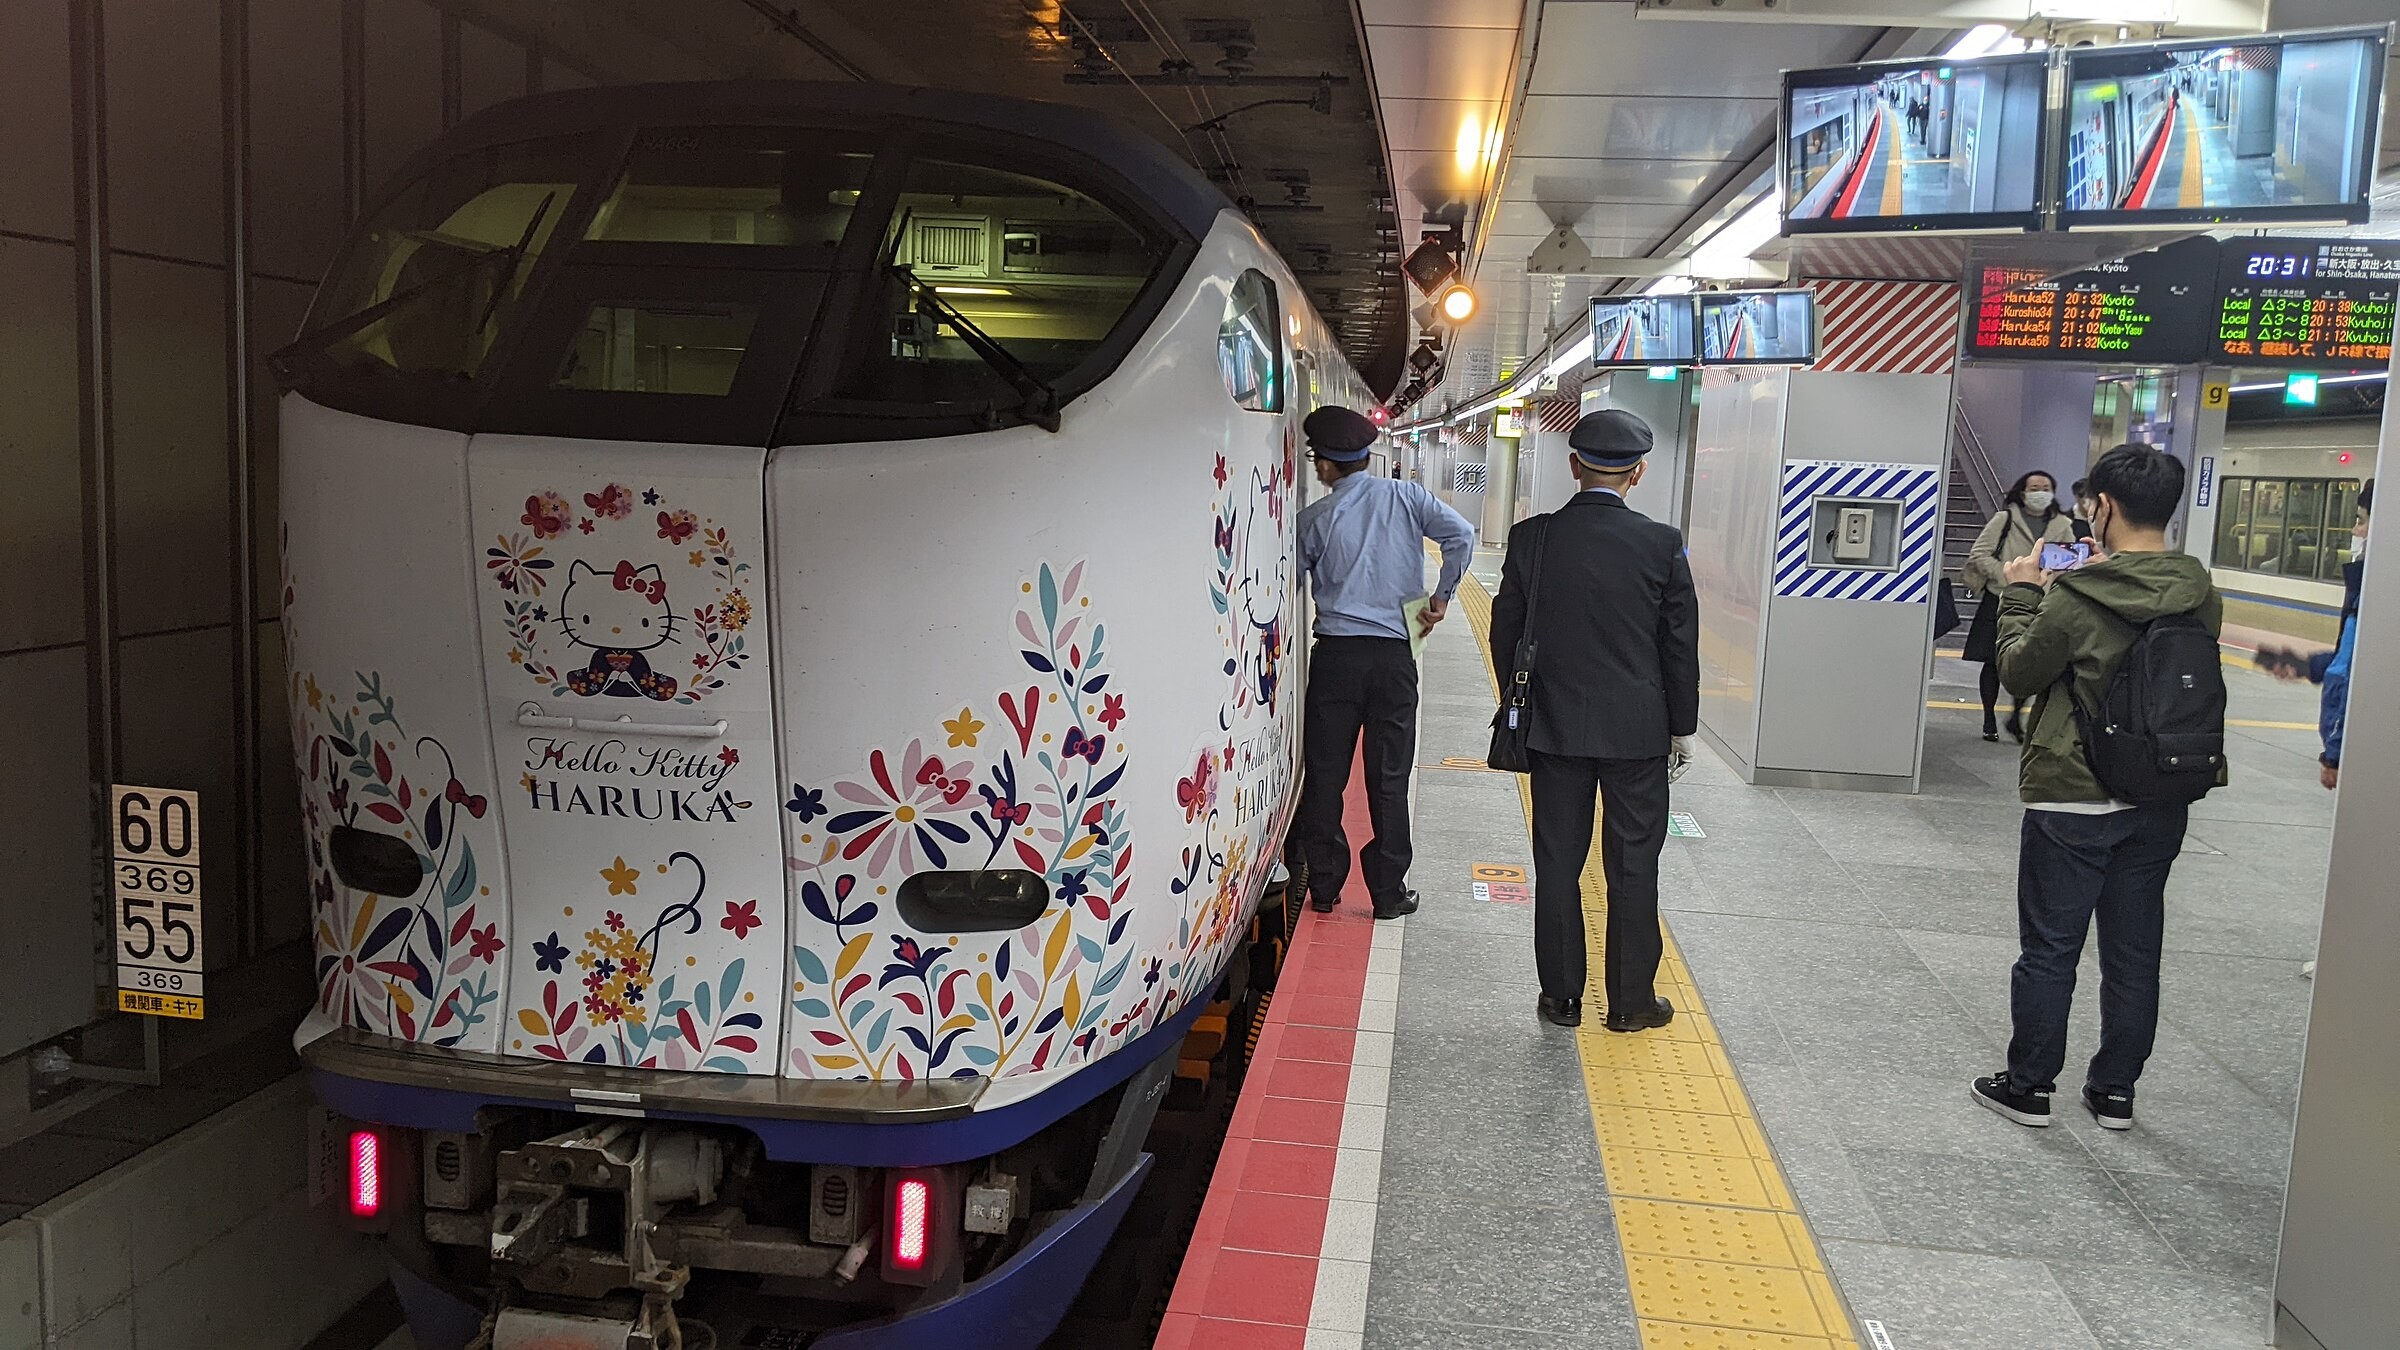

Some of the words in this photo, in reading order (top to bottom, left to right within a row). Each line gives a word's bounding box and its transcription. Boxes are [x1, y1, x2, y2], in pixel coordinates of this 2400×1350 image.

[2247, 256, 2309, 276] 20:31
[2315, 269, 2326, 278] for
[2004, 292, 2056, 305] Haruka52
[2065, 293, 2102, 306] 20:32
[2102, 293, 2135, 306] Kyoto
[2223, 298, 2252, 311] Local
[2312, 300, 2351, 313] 20:38
[2350, 301, 2395, 314] Kyuhoji
[2003, 305, 2052, 319] Kuroshio34
[2063, 307, 2100, 320] 20:47
[2221, 312, 2249, 325] Local
[2309, 314, 2348, 327] 20:53
[2347, 316, 2393, 330] Kyuhoji
[2001, 320, 2051, 333] Haruka54
[2061, 322, 2100, 334] 21:02
[2219, 327, 2247, 340] Local
[2307, 329, 2346, 342] 21:12
[2345, 330, 2390, 344] Kyuhoji
[1999, 334, 2049, 347] Haruka56
[2059, 335, 2098, 349] 21:32
[2096, 336, 2129, 349] Kyoto
[2209, 386, 2223, 404] g
[525, 736, 626, 774] Hello
[629, 744, 740, 792] Kitty
[530, 779, 752, 823] HARUKA
[119, 791, 192, 858] 60
[119, 865, 194, 894] 369
[122, 897, 195, 964] 55
[137, 971, 183, 990] 369
[124, 993, 198, 1016] 機関車・キヤ
